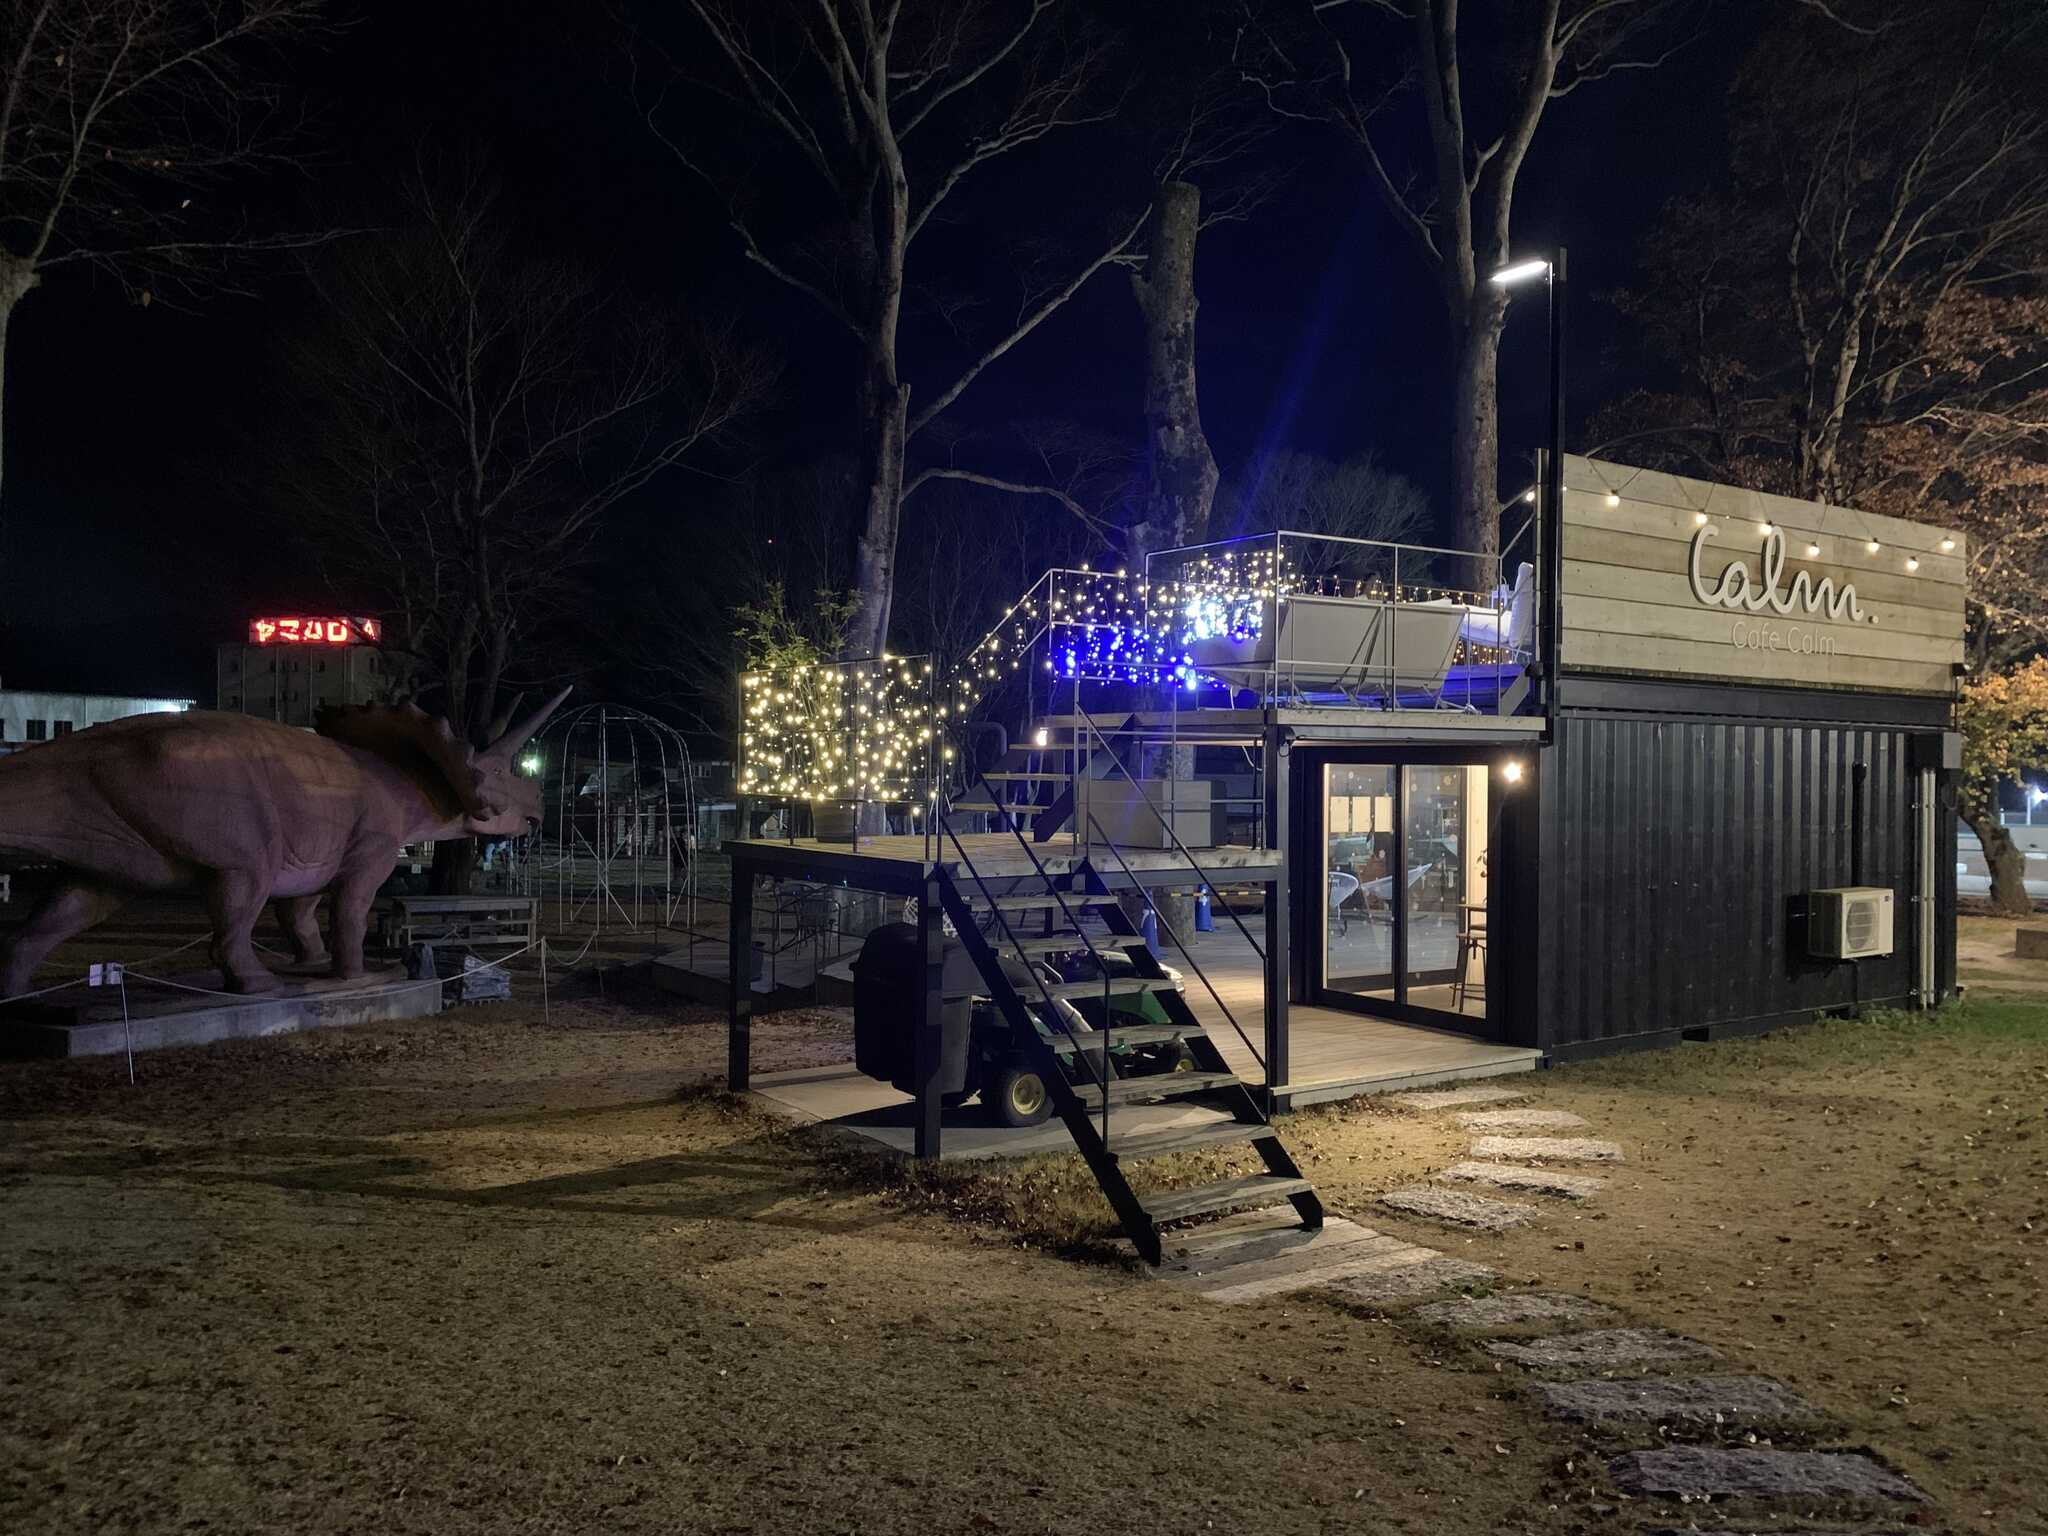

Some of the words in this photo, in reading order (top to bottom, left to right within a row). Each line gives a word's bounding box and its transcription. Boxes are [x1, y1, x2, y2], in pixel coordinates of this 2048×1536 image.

[1690, 524, 1879, 621] Calm.
[1732, 620, 1780, 649] Cafe
[1787, 626, 1836, 656] Calm
